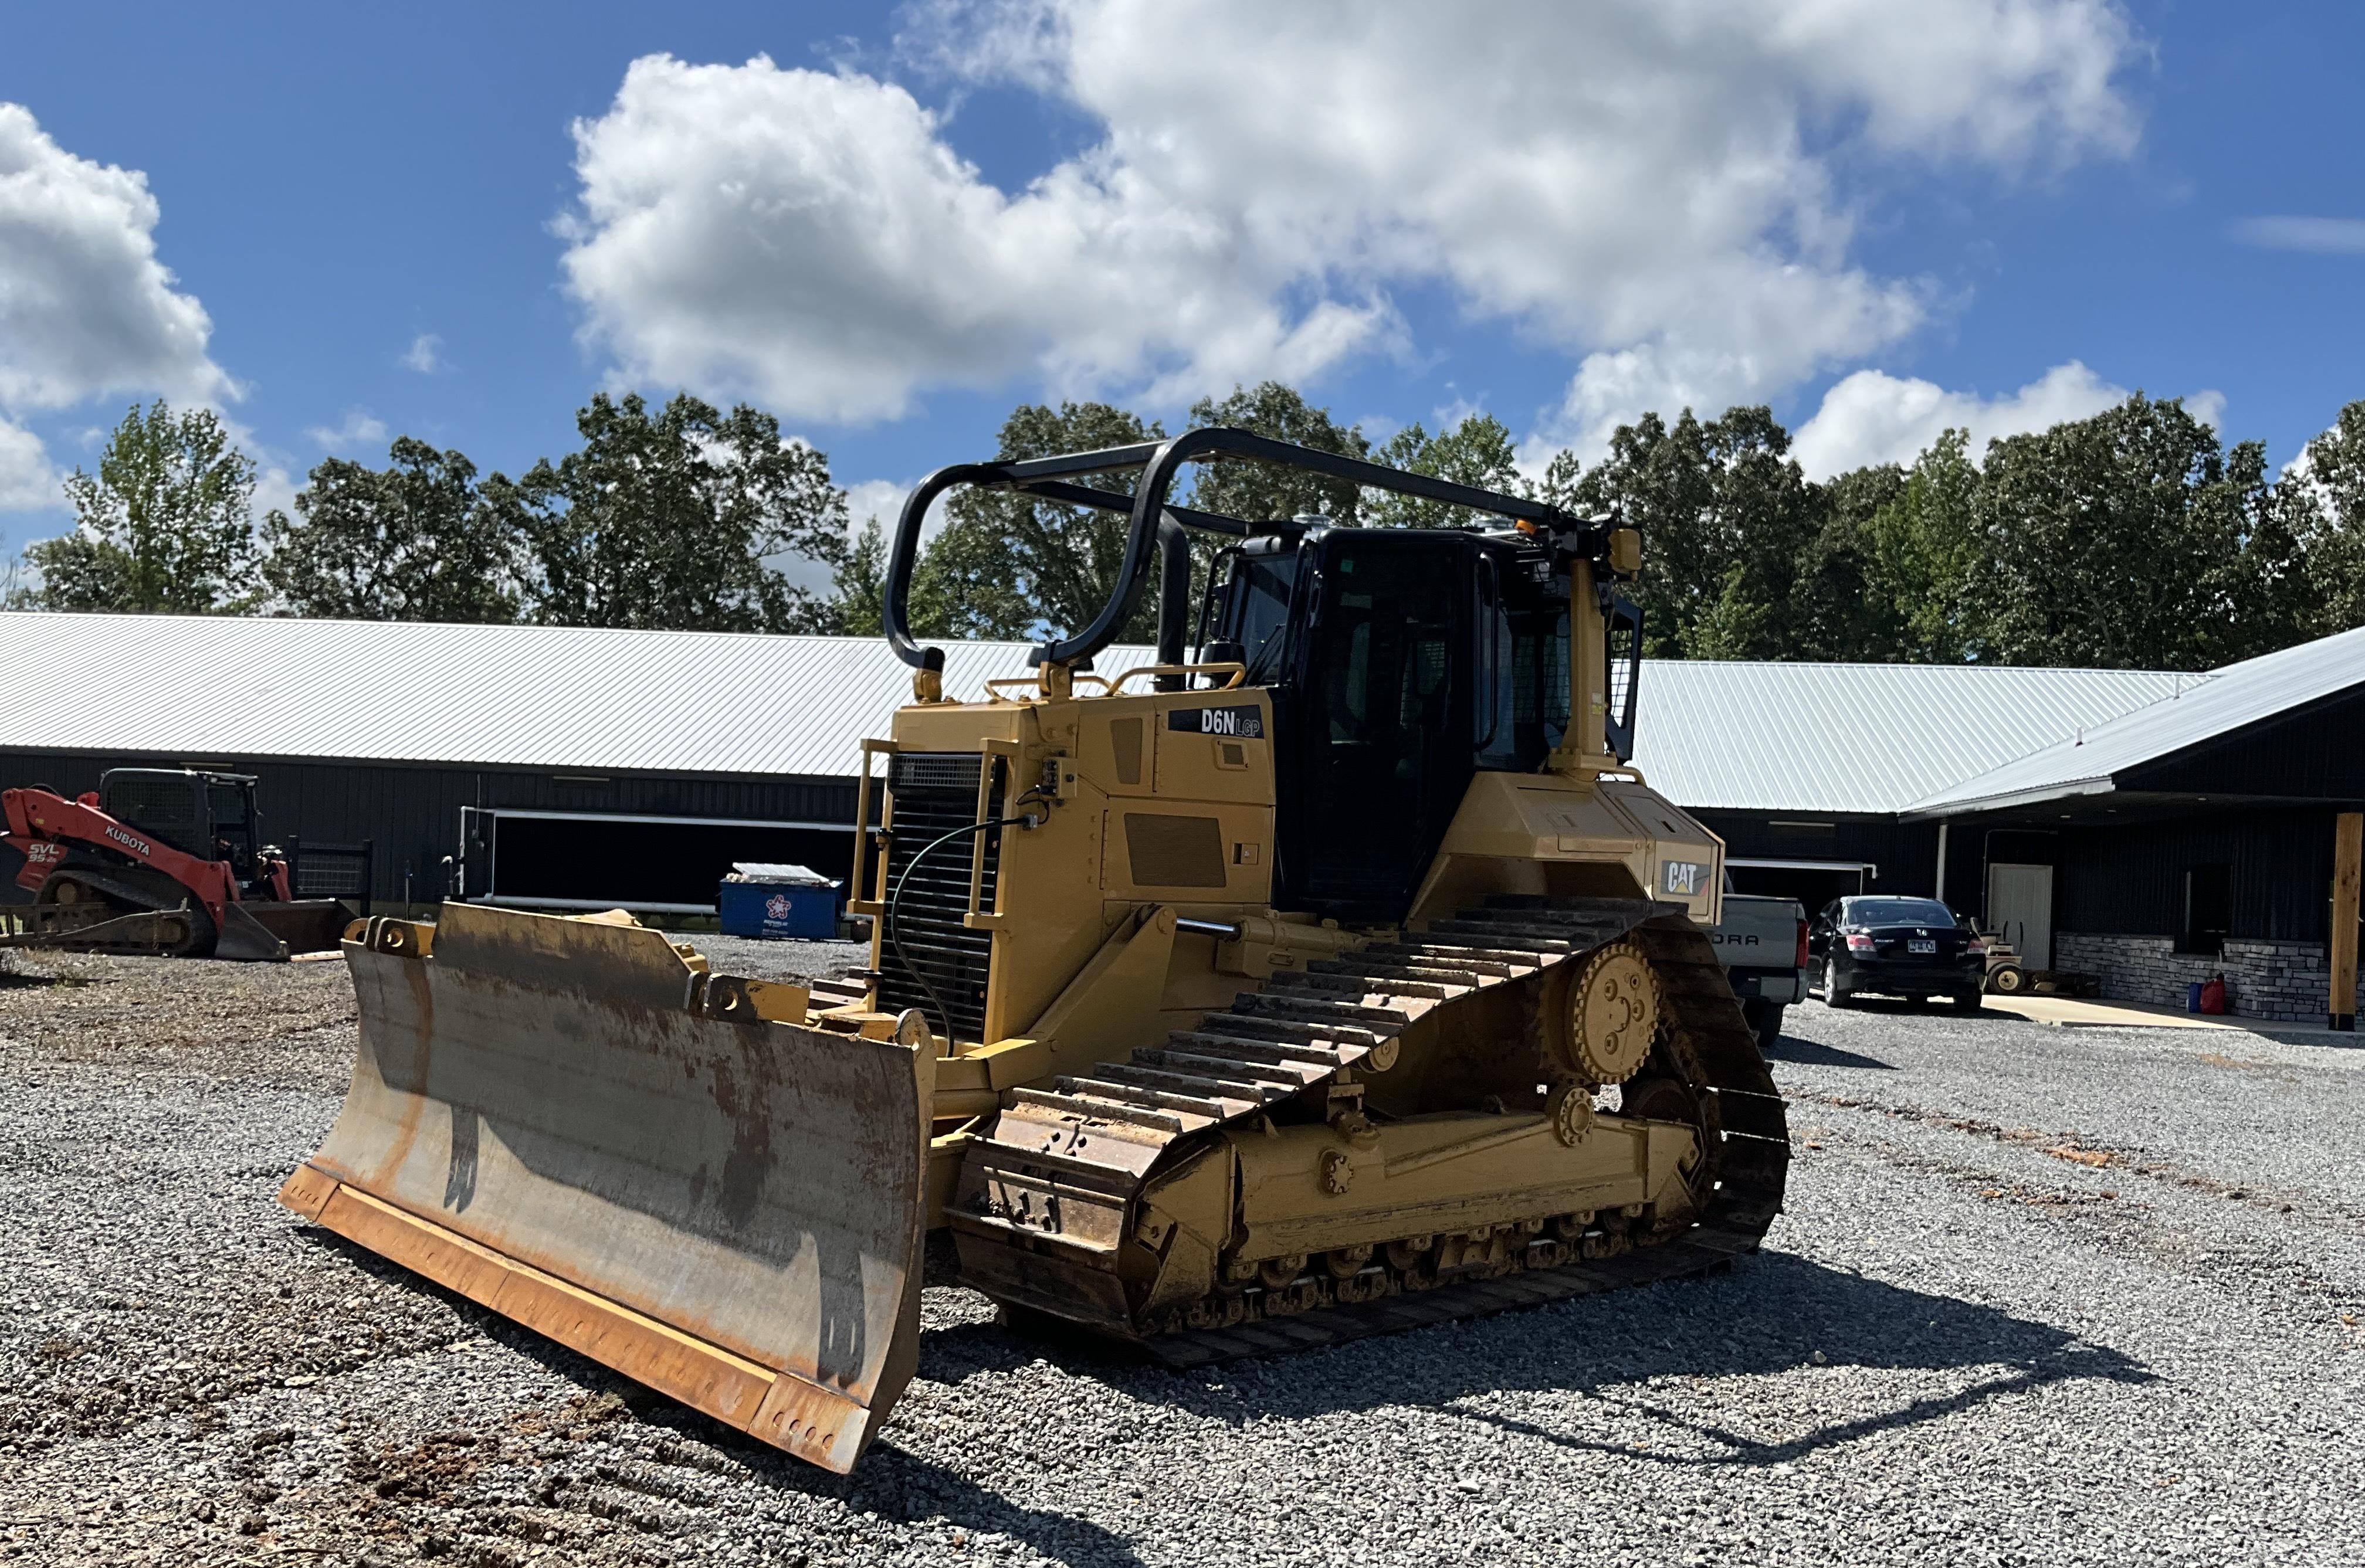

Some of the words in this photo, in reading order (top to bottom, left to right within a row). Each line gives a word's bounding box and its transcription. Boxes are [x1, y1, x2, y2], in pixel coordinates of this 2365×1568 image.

[1202, 709, 1235, 734] D6N
[1235, 719, 1260, 737] LGP
[28, 844, 60, 854] SVL
[105, 826, 150, 856] KUBOTA
[1668, 862, 1696, 894] CAT
[1712, 934, 1758, 945] DRA
